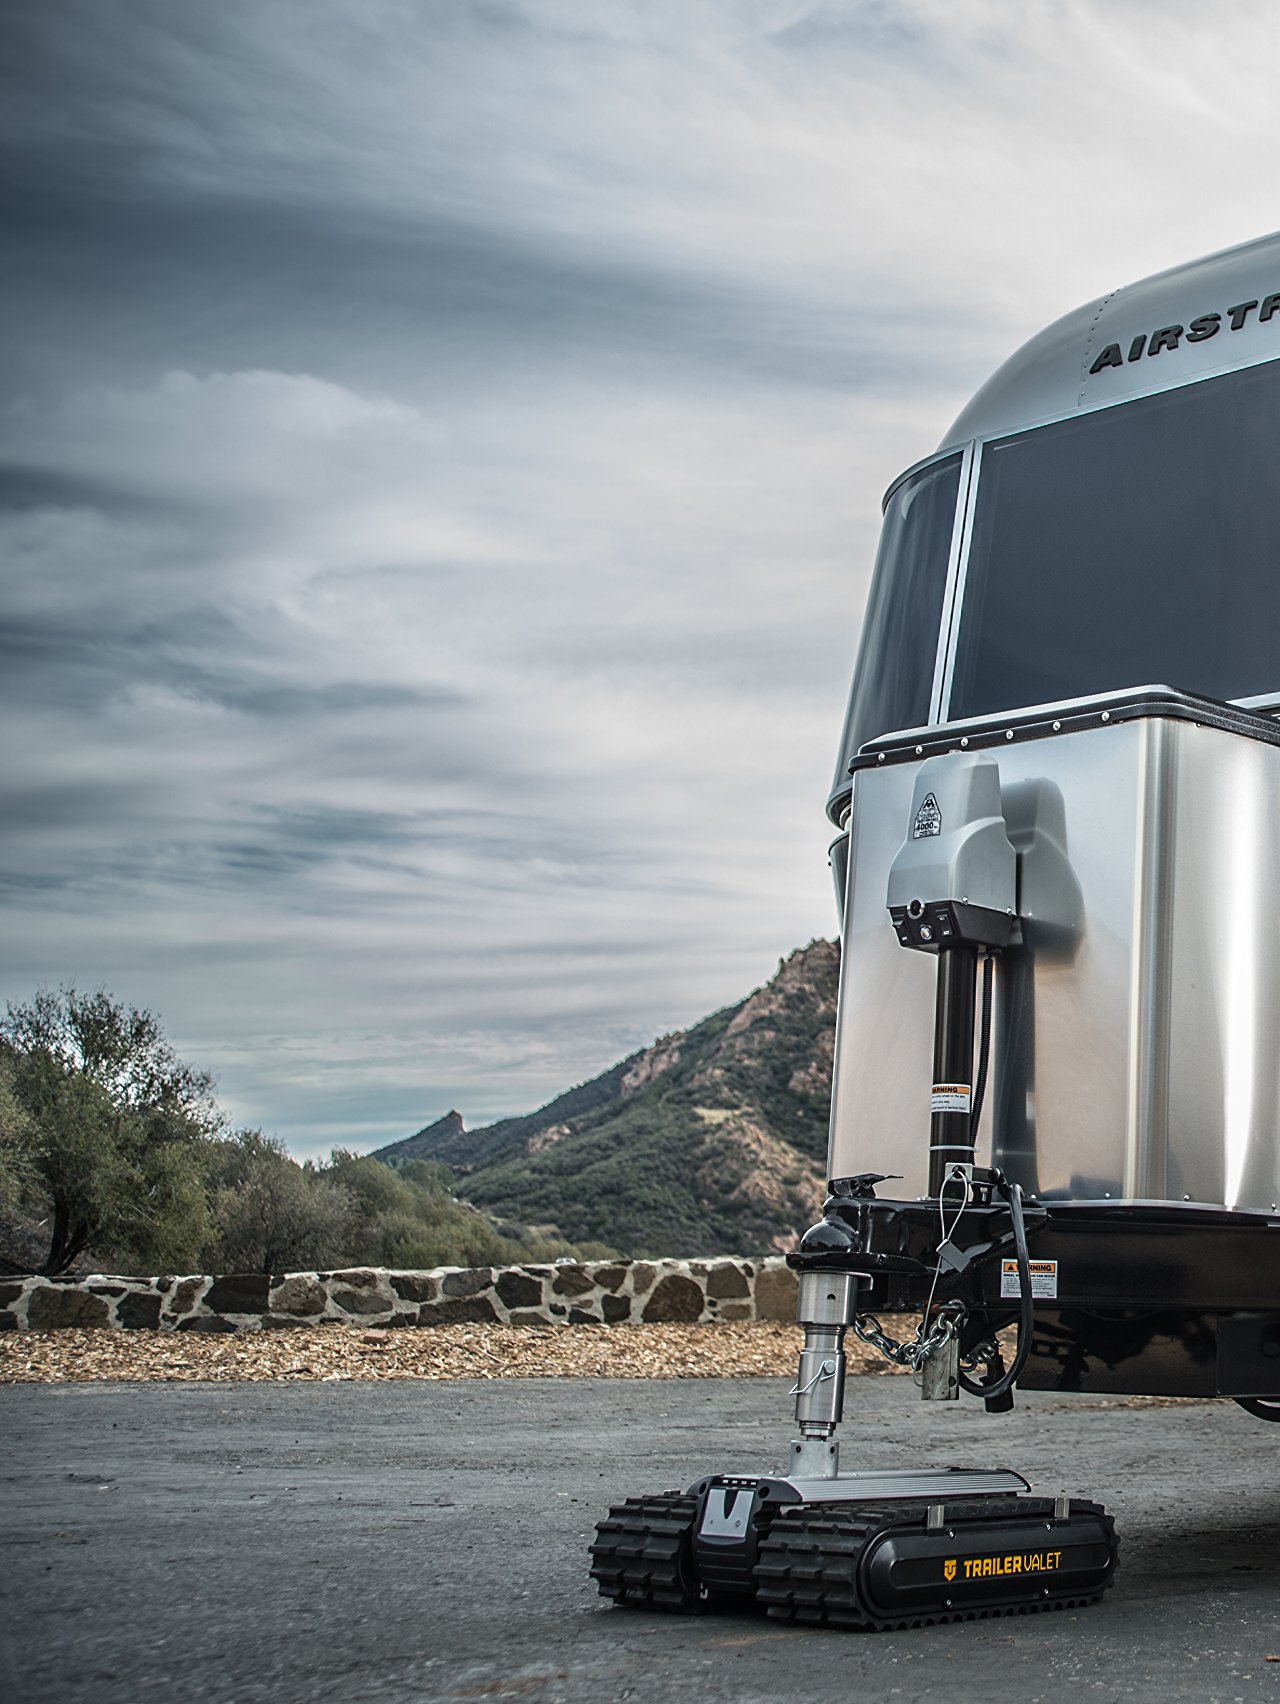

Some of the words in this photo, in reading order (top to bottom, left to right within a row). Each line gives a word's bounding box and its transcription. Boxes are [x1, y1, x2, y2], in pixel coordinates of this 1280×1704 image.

[916, 822, 934, 831] 4000
[932, 1086, 958, 1094] ARNING
[1016, 1263, 1052, 1272] RNING
